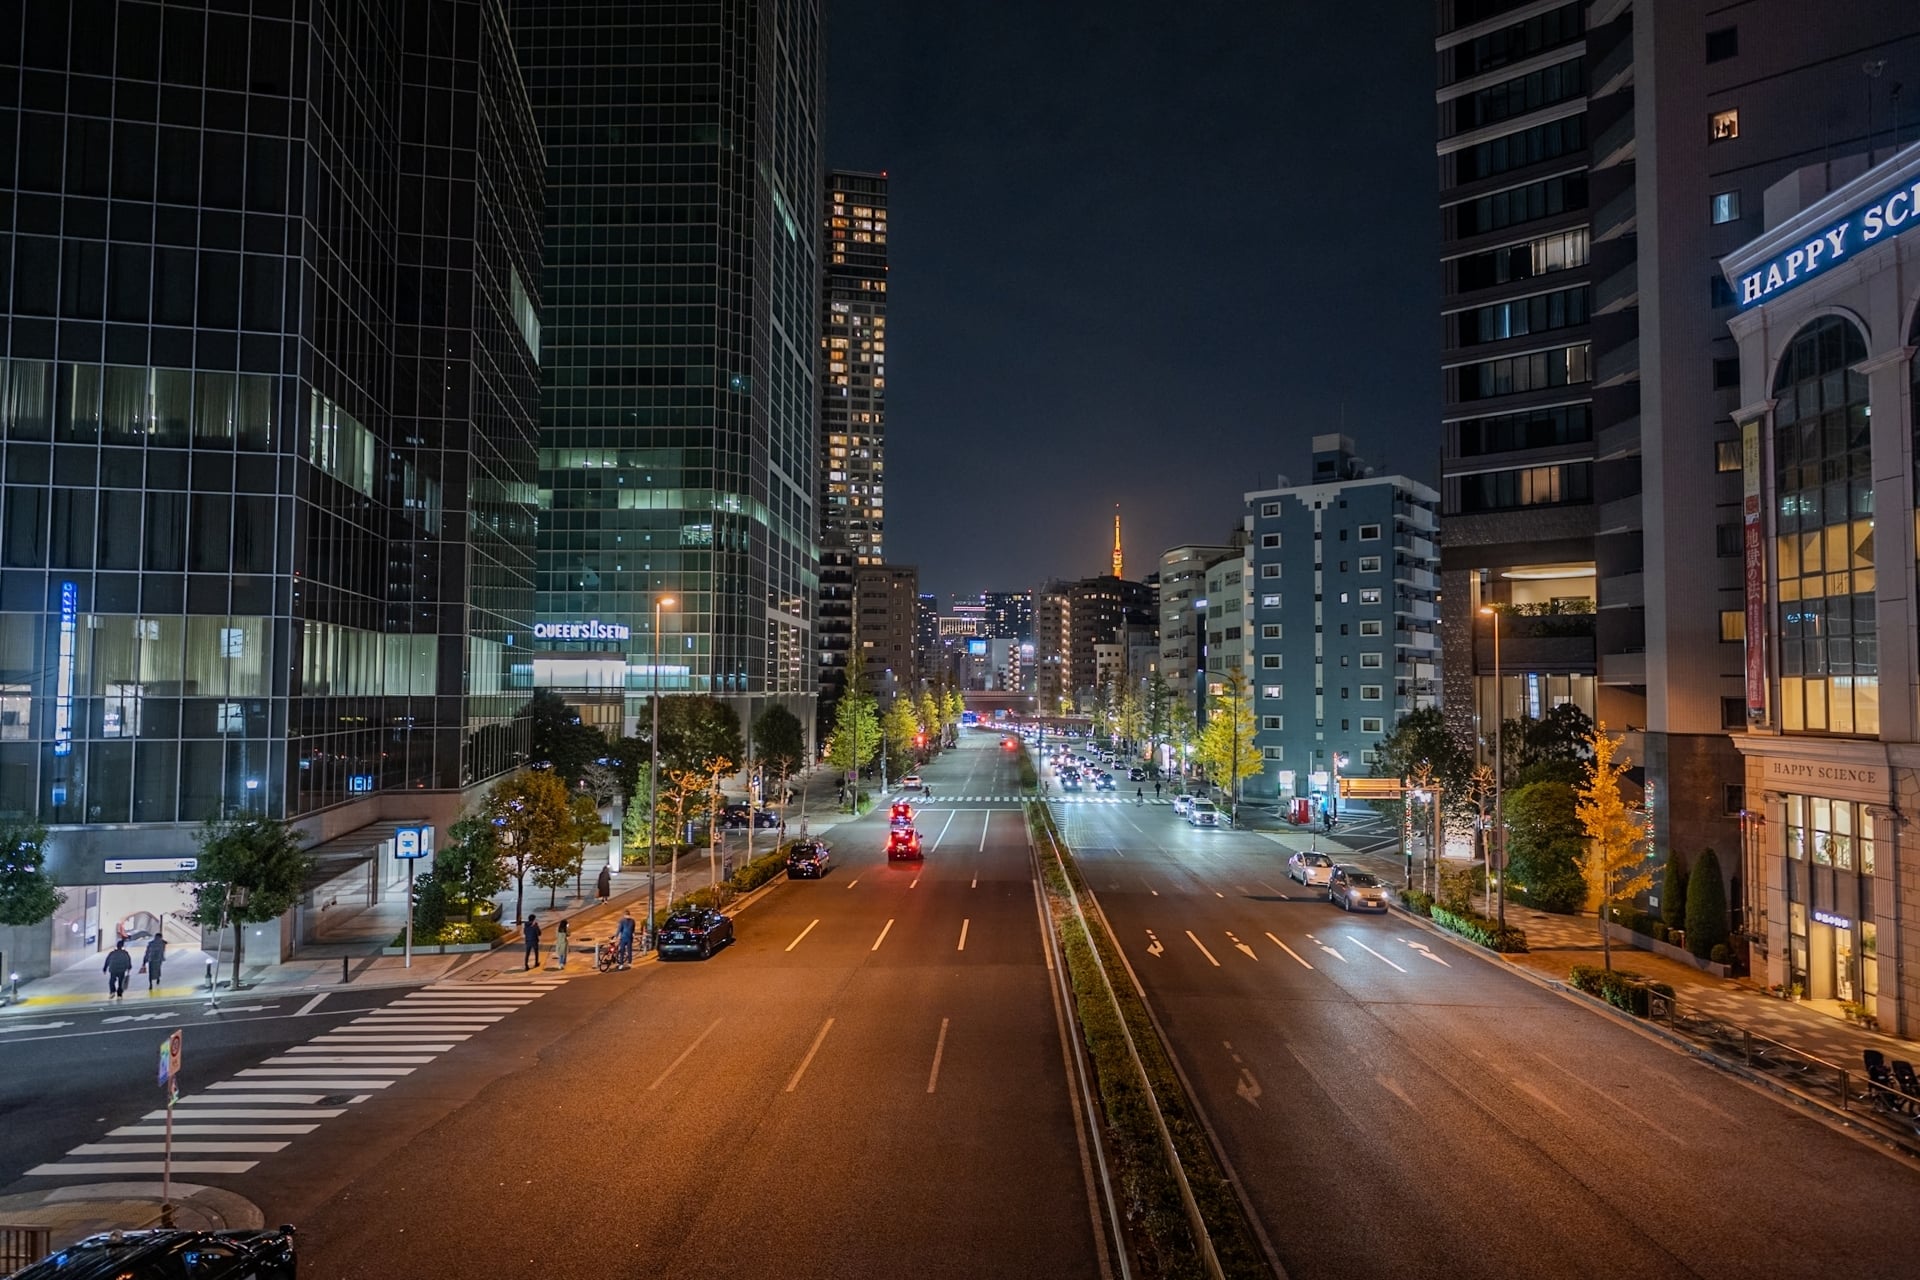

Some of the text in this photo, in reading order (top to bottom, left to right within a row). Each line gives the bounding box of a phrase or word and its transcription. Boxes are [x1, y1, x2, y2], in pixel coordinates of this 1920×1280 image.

[1742, 222, 1849, 305] HAPPY
[534, 622, 589, 638] QUEEN'S
[1773, 762, 1877, 783] HAPPY SCIENCE
